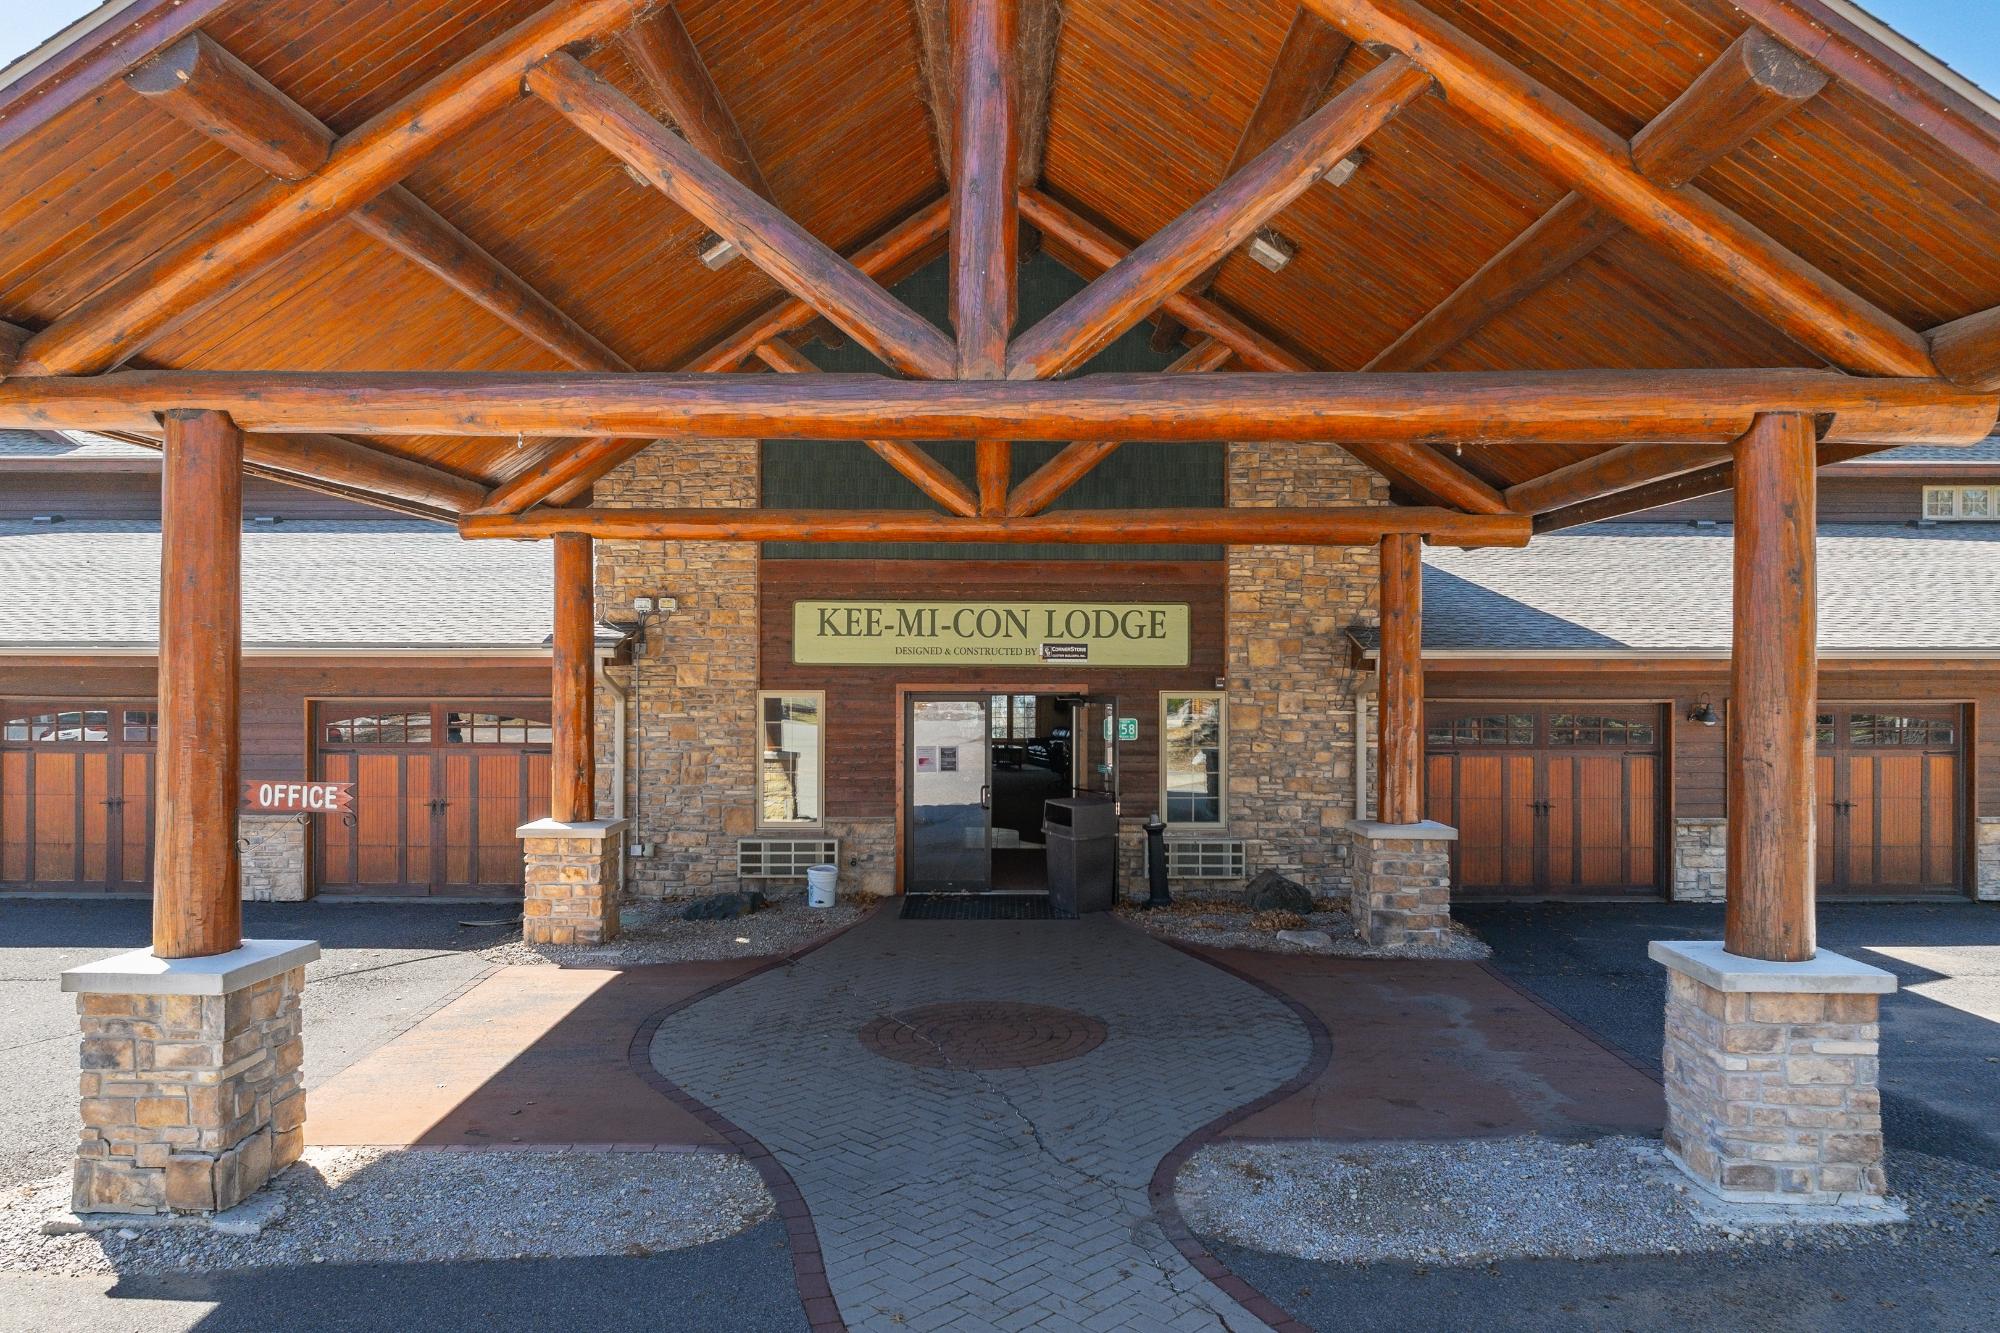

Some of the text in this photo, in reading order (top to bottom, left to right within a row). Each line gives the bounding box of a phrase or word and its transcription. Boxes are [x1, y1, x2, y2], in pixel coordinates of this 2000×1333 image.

[817, 608, 1167, 640] KEE-MI-CON LODGE
[895, 646, 1038, 656] DESIGNED & CONSTRUCTED BY
[259, 783, 338, 810] OFFICE
